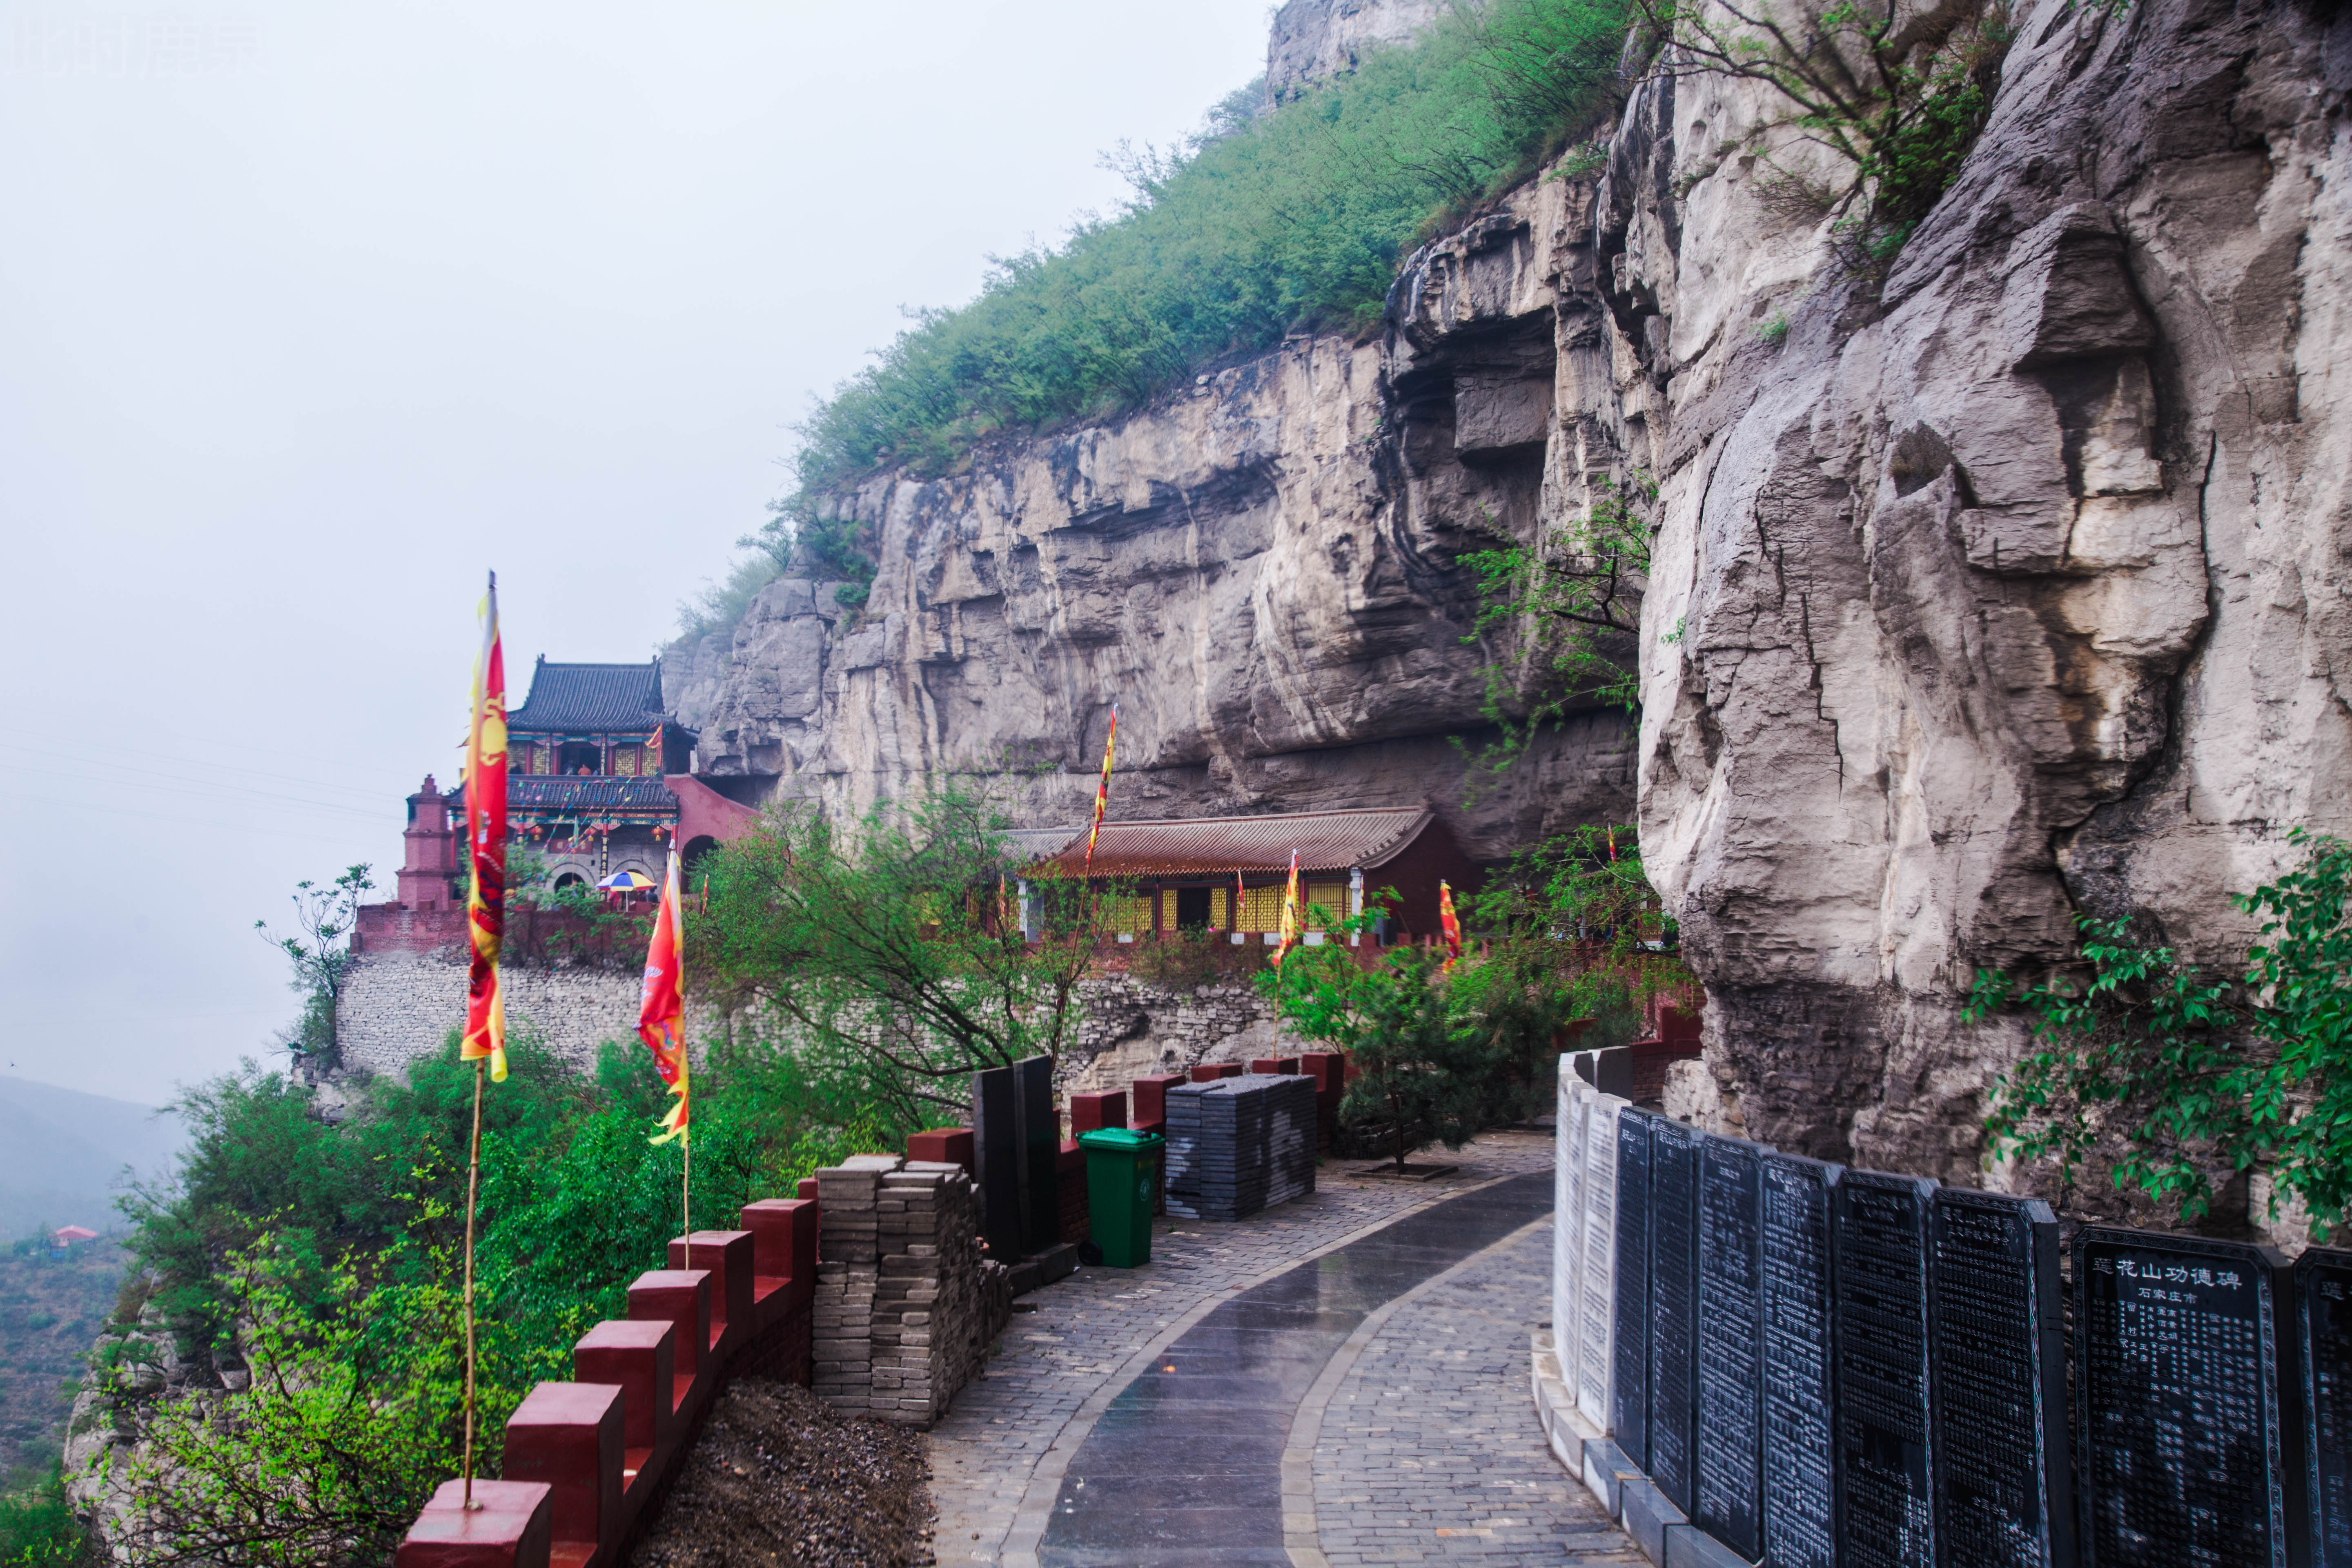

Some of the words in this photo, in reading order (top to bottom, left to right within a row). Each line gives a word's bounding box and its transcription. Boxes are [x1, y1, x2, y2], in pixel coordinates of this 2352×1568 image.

[2092, 1257, 2243, 1290] 莲花山功德碑
[2138, 1287, 2198, 1304] 石家庄市
